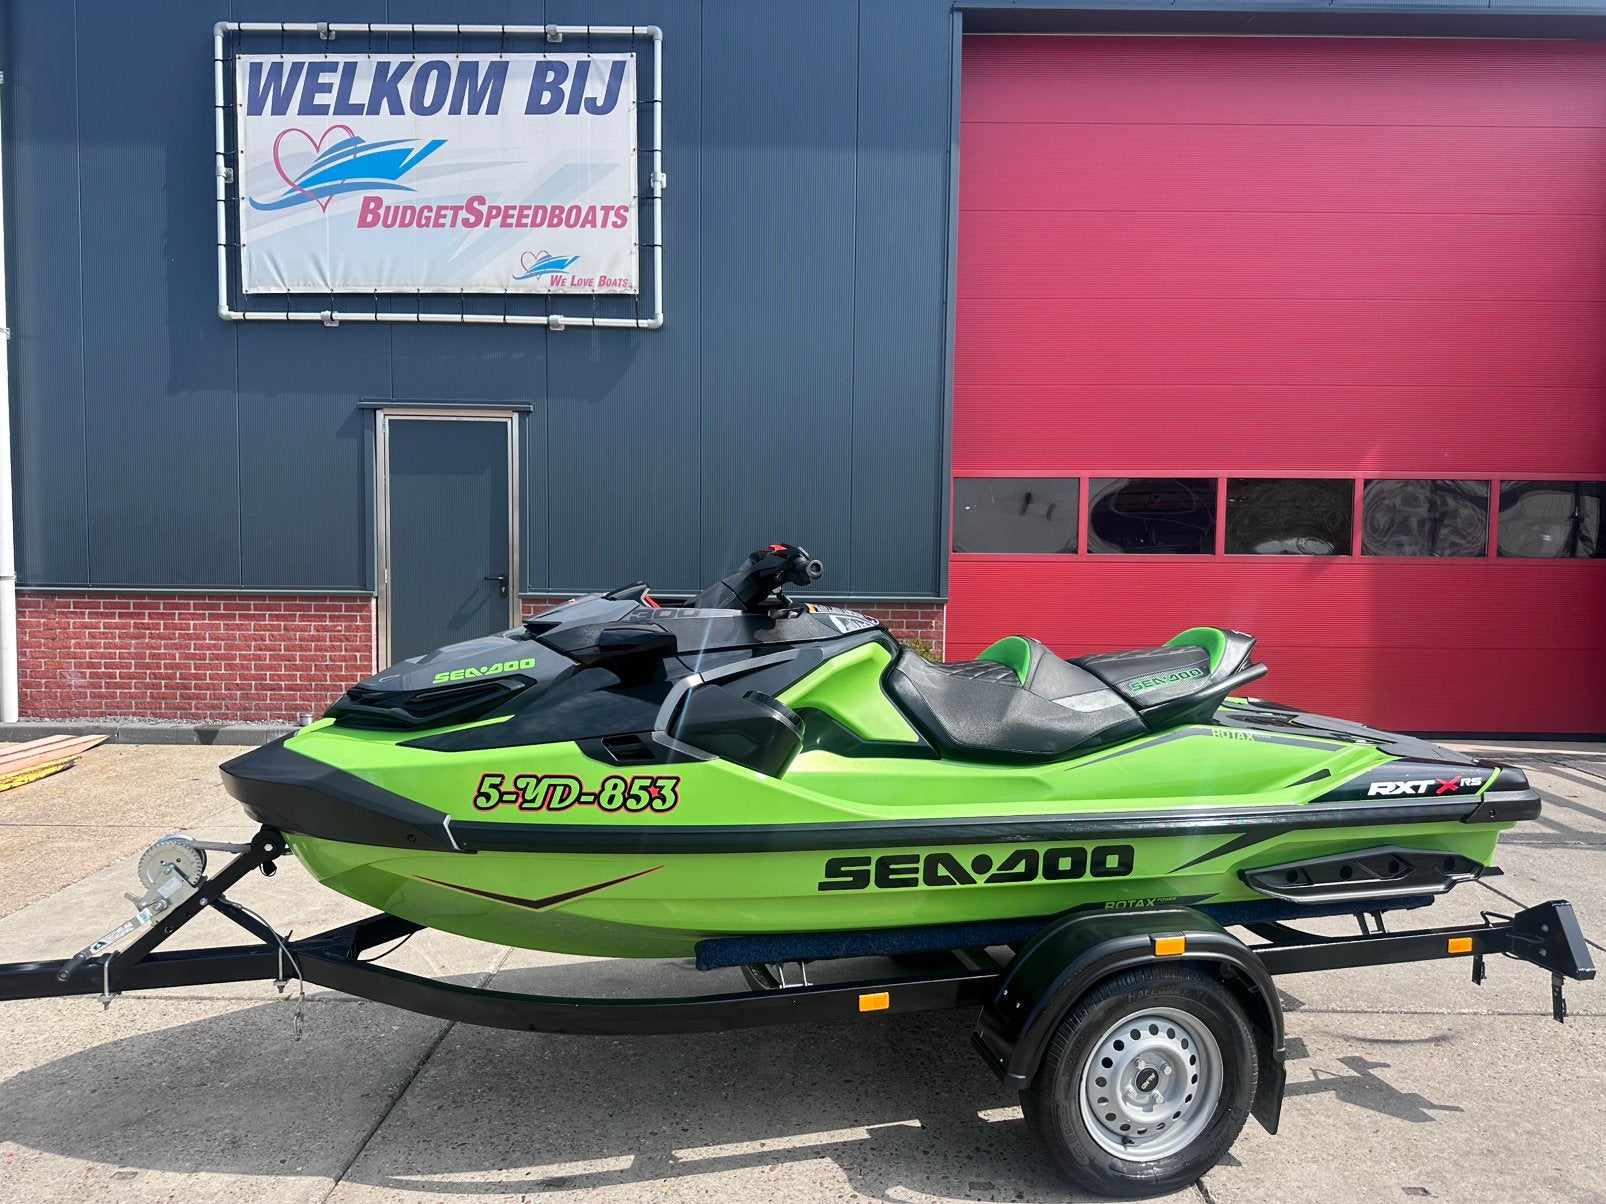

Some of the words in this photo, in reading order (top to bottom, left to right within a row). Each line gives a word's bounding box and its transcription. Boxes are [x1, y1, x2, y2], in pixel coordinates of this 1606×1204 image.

[246, 60, 510, 117] WELKOM
[525, 60, 626, 116] BIJ
[550, 274, 567, 287] WE
[570, 275, 594, 287] LOVE
[598, 275, 628, 288] BOATS
[629, 608, 701, 620] 300
[1211, 728, 1255, 742] ROTAX
[474, 773, 680, 812] 5-YD-853
[1367, 779, 1436, 796] RXT
[1460, 776, 1482, 787] RS
[1105, 898, 1157, 910] ROTAX
